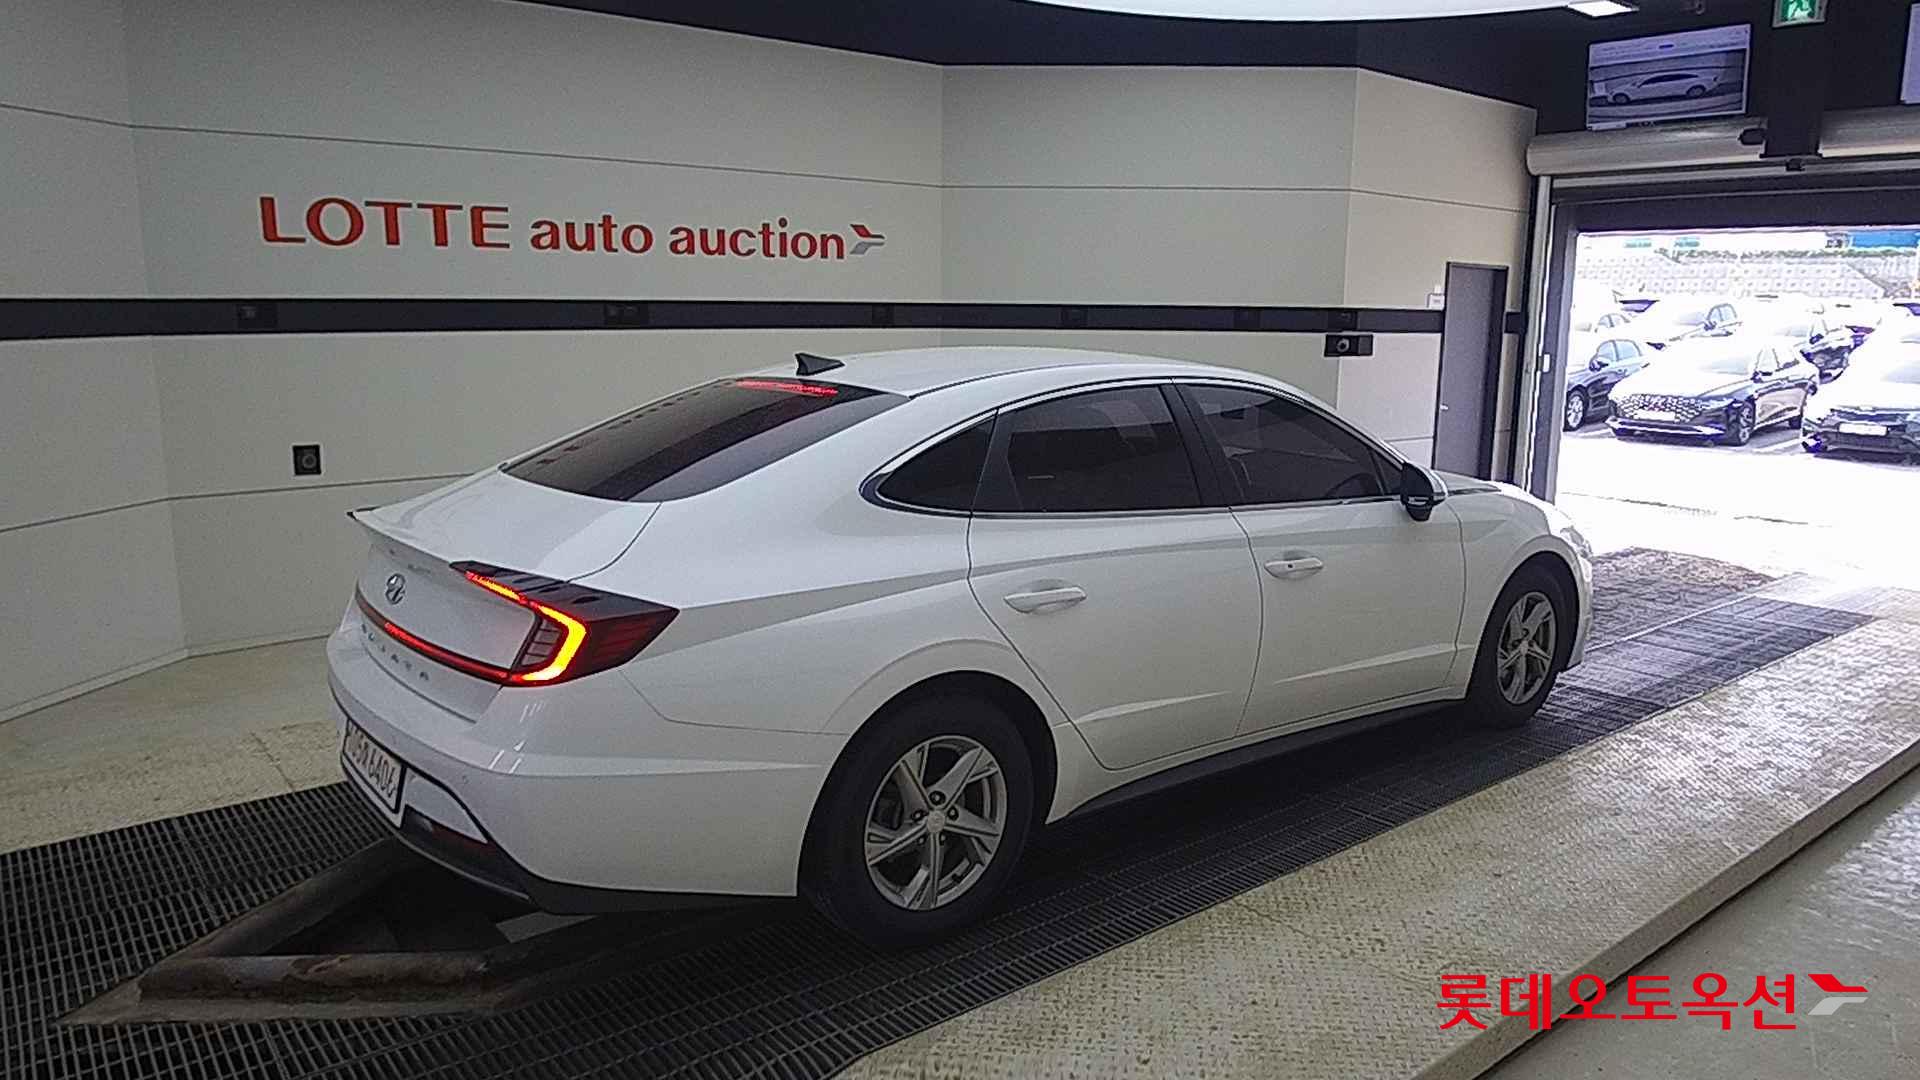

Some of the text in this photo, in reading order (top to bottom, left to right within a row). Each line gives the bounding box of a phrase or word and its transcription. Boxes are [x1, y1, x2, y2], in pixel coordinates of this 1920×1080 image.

[259, 196, 846, 260] LOTTE auto auction
